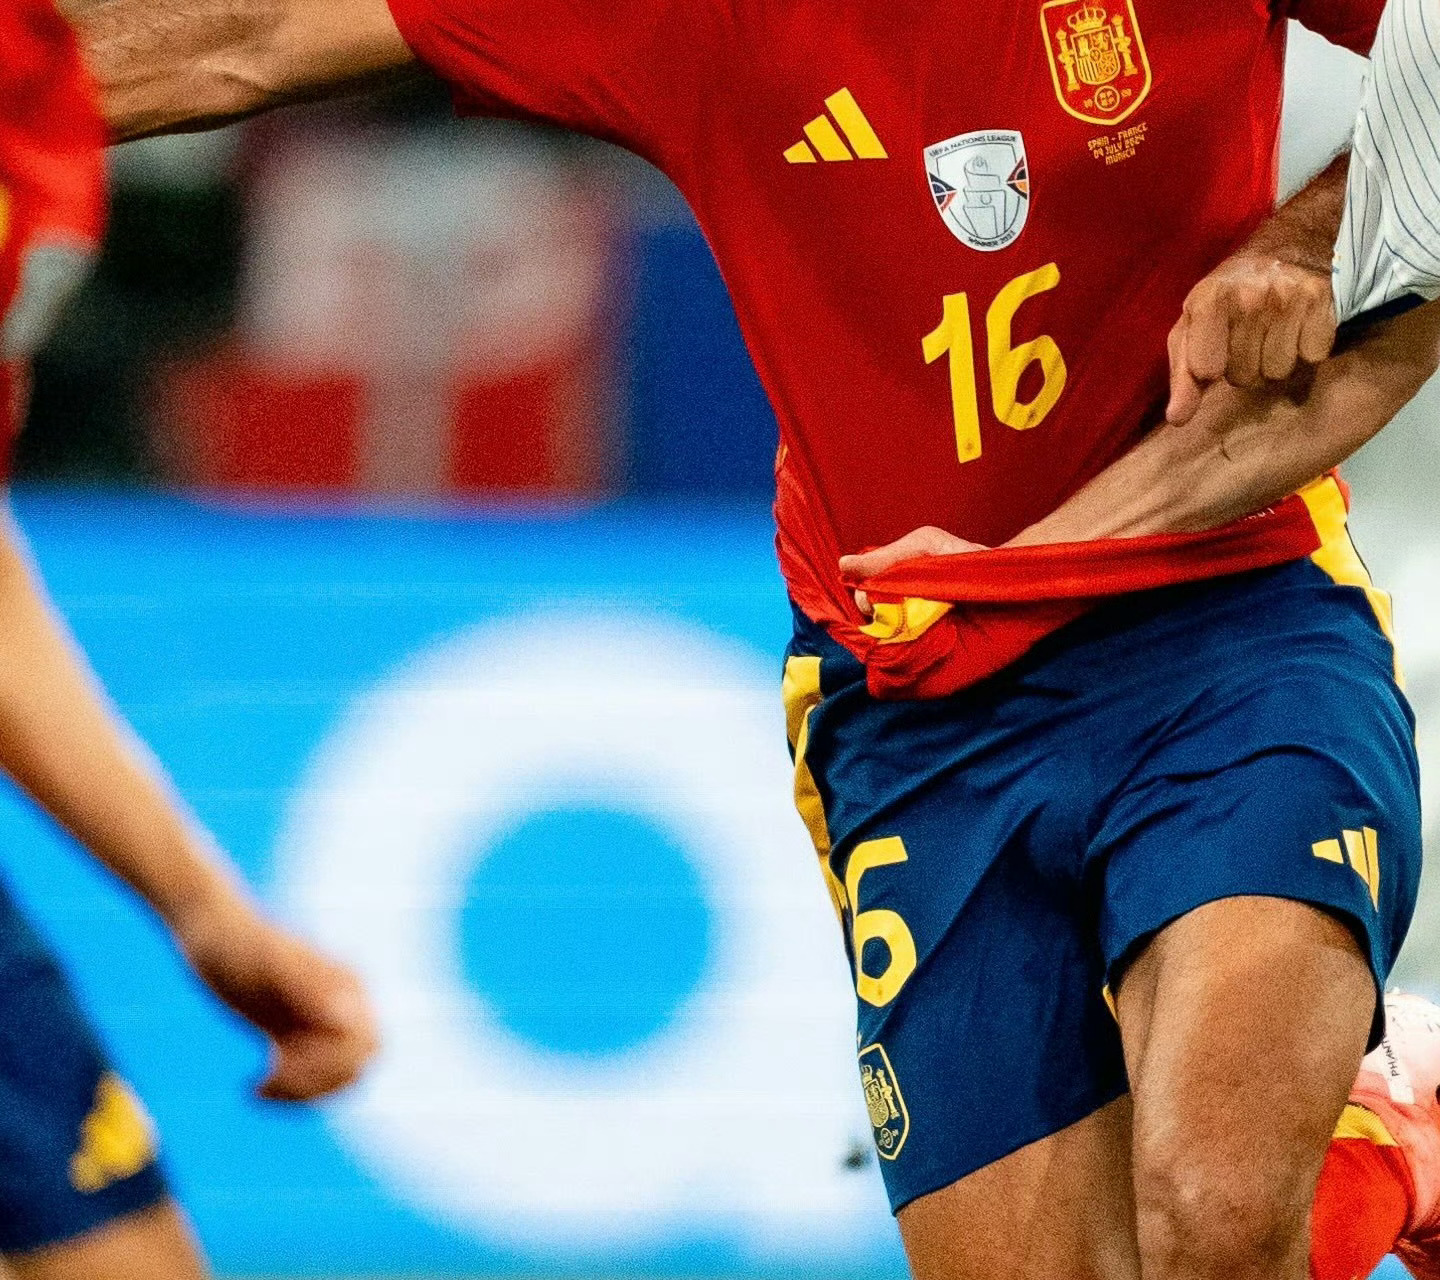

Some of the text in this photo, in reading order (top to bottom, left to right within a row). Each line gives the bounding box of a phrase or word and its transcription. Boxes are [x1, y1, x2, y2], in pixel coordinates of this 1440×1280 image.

[1118, 122, 1148, 141] FRANCE
[929, 134, 1017, 157] UEFA NATIONS LEAGUE
[1105, 141, 1122, 155] JULY
[1106, 148, 1136, 165] MUNICH
[921, 261, 1067, 464] 16
